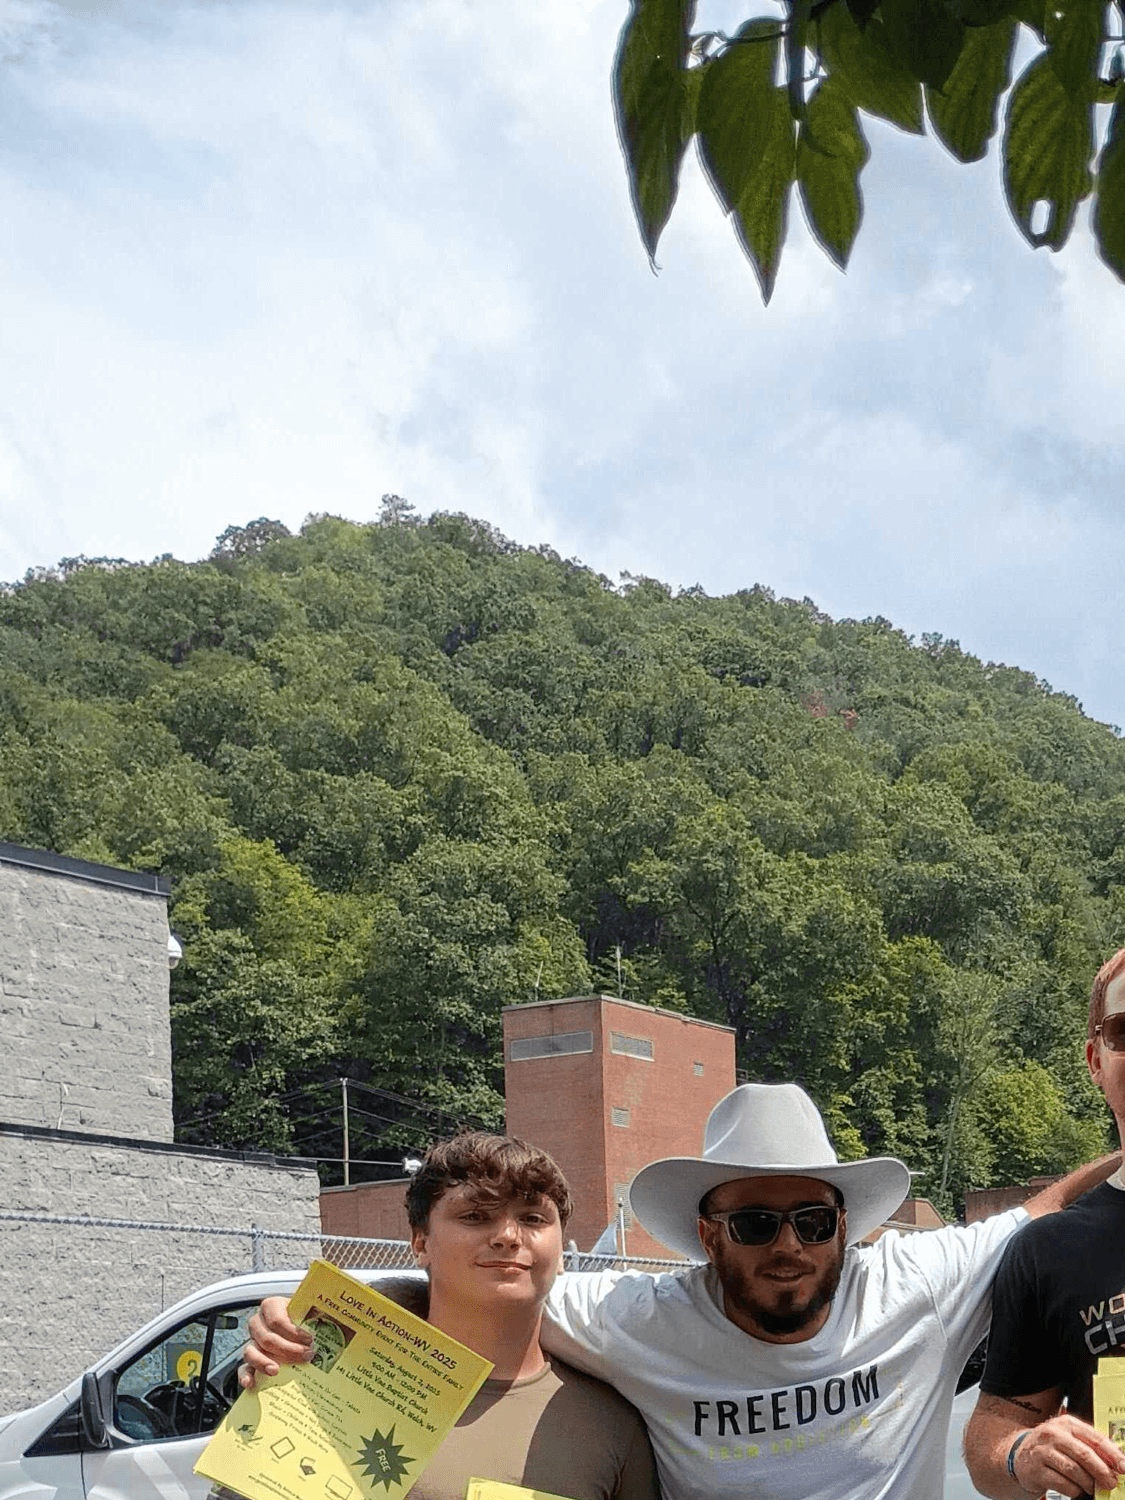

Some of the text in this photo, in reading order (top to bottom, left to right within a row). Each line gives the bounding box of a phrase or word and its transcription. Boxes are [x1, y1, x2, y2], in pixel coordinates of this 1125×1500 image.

[339, 1289, 365, 1311] LOVE
[377, 1313, 430, 1352] ACTION-WV
[429, 1347, 458, 1371] 2025
[693, 1364, 880, 1436] FREEDOM
[375, 1448, 391, 1473] FREE
